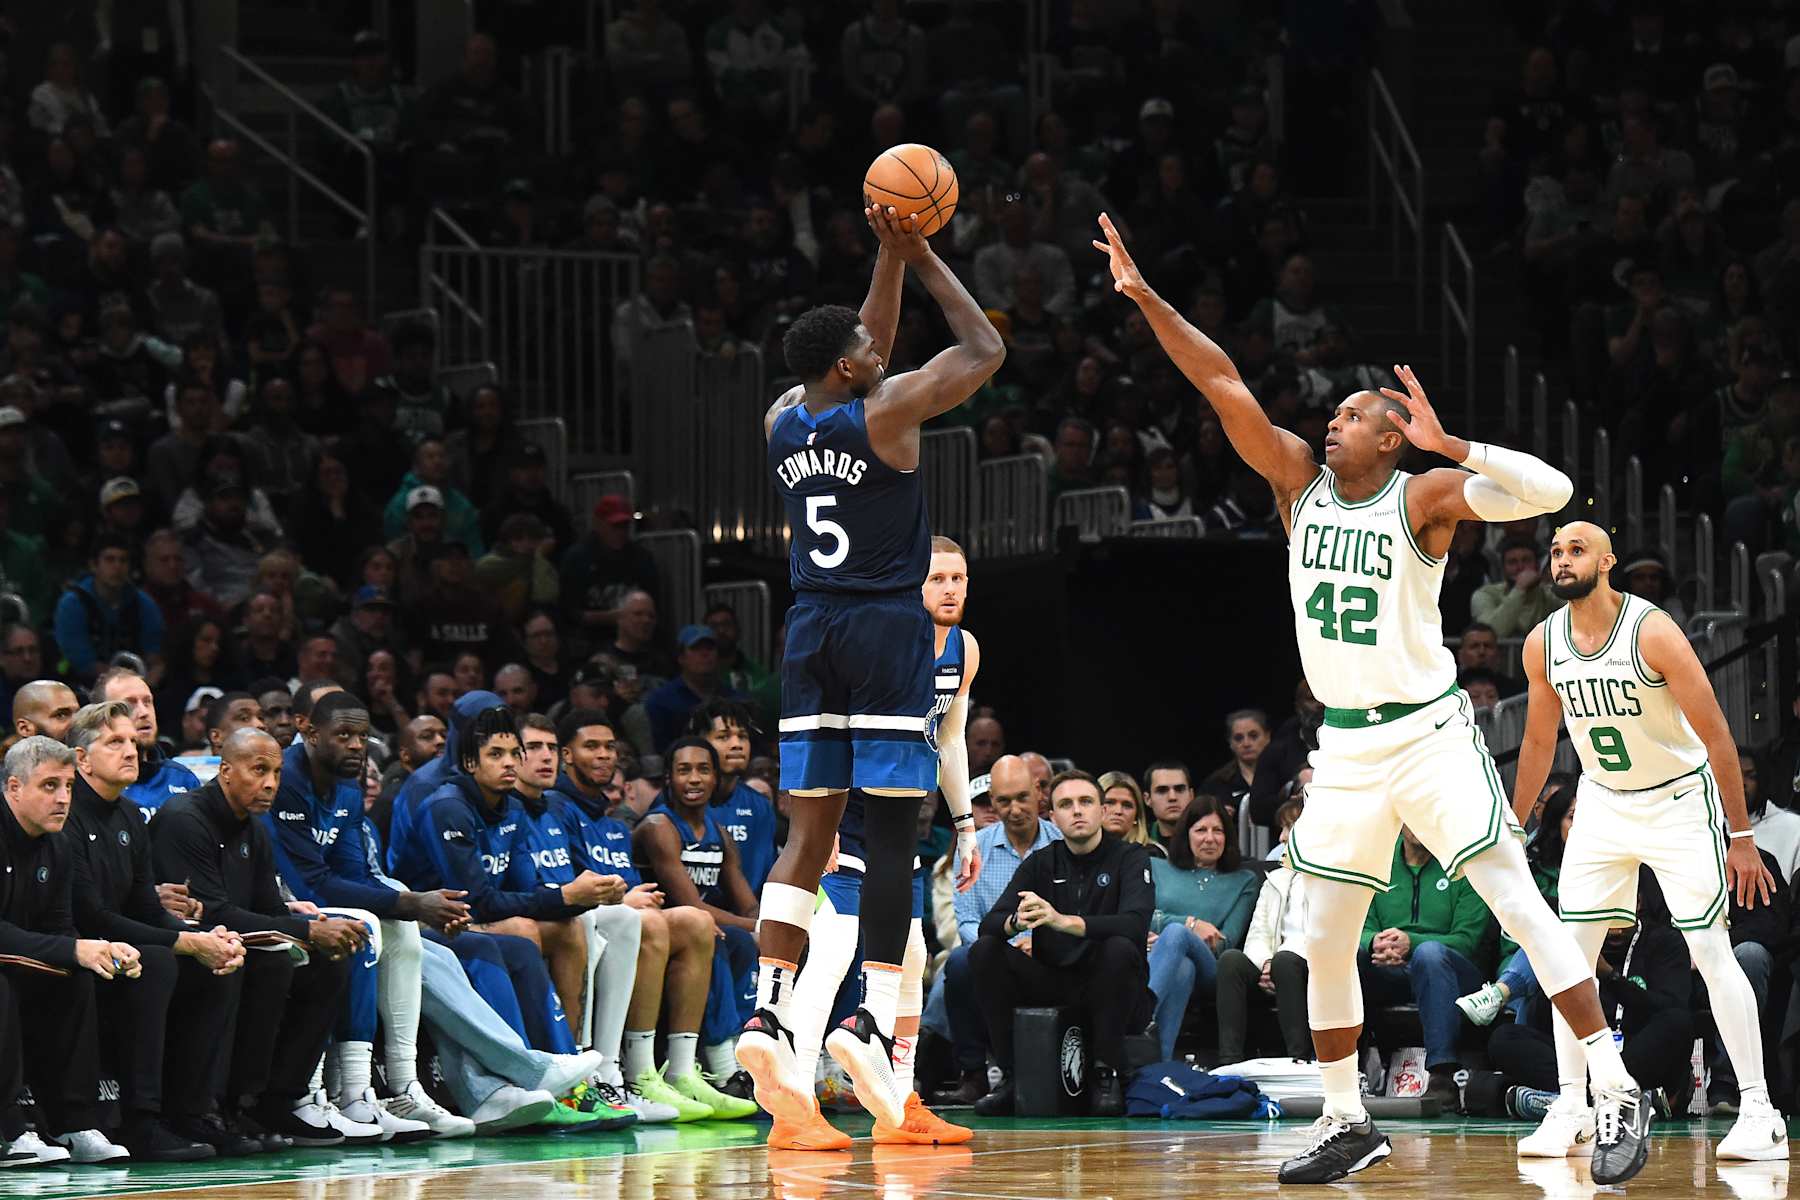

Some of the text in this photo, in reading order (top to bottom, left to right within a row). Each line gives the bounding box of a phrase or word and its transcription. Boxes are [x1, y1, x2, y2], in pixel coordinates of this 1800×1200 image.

[776, 449, 868, 490] EDWARDS
[806, 495, 850, 569] 5
[1302, 523, 1393, 580] CELTICS
[1305, 581, 1379, 646] 42
[1588, 726, 1633, 772] 9
